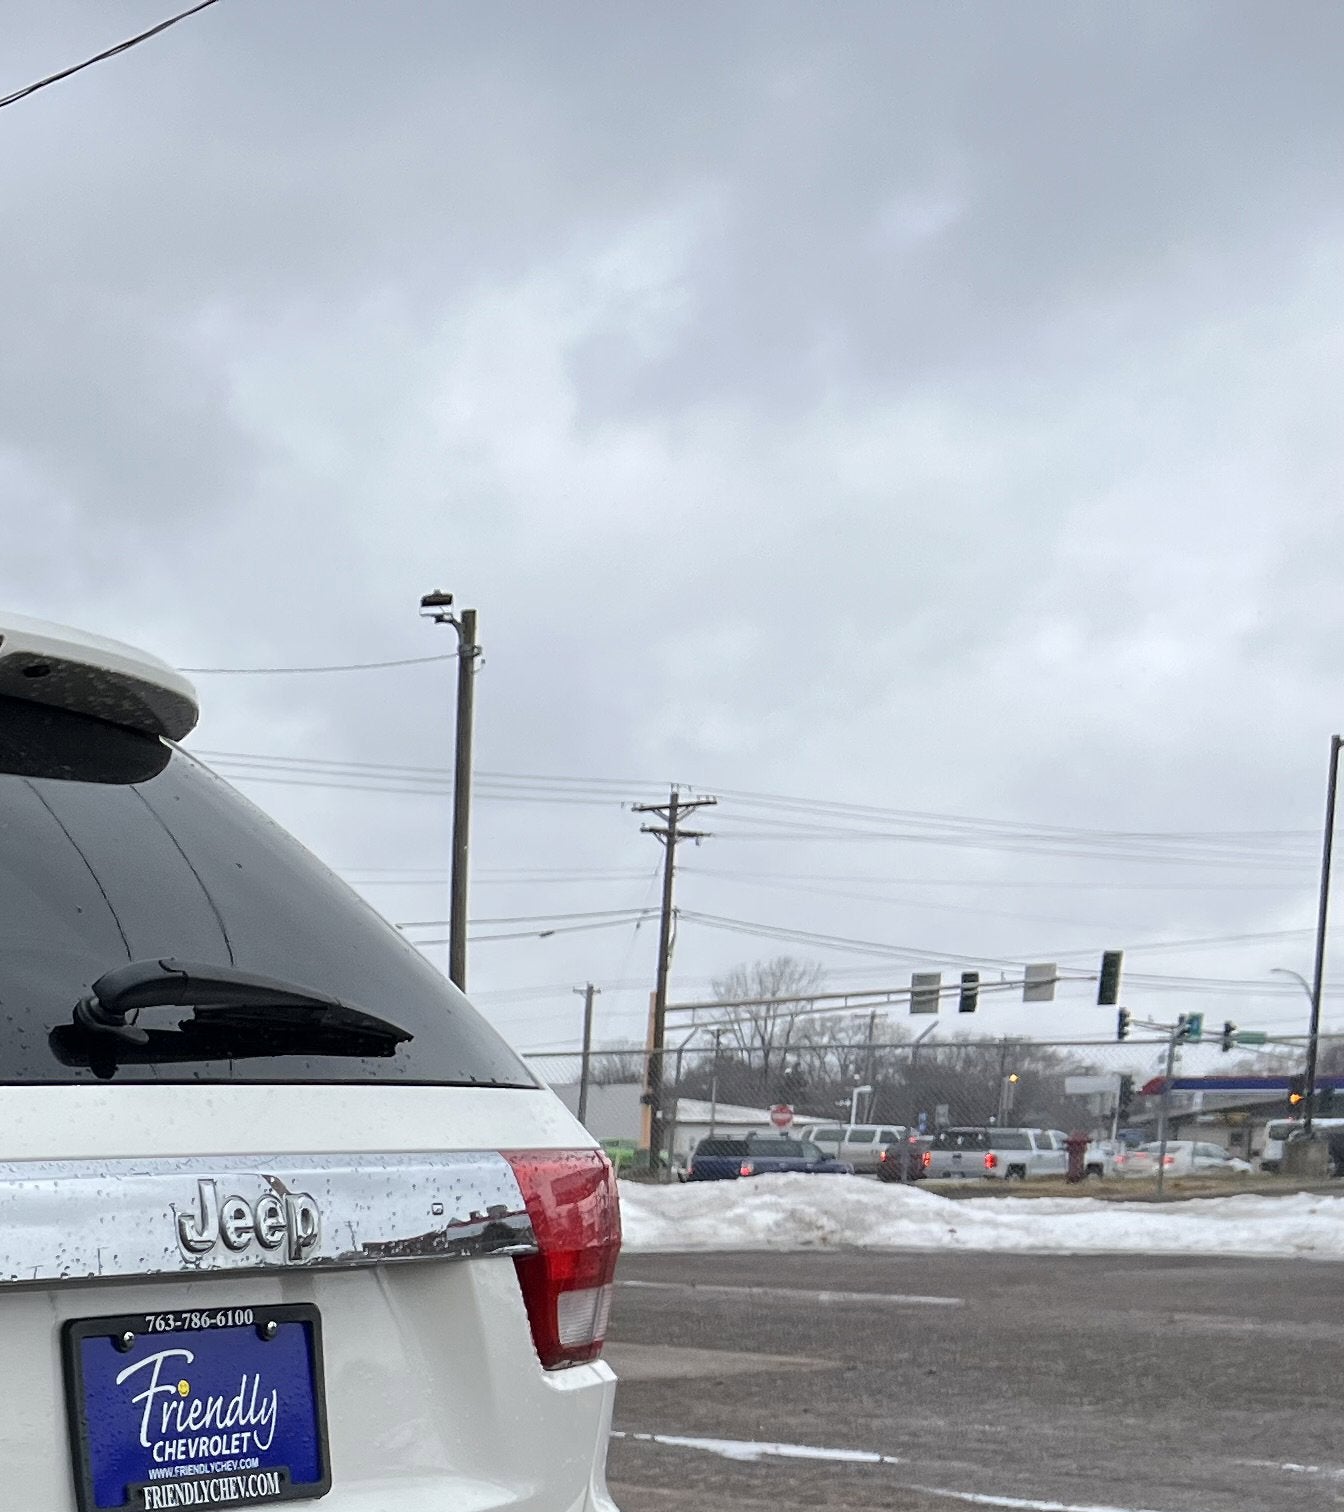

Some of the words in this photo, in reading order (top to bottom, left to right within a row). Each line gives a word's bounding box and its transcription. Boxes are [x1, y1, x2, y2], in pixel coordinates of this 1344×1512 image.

[176, 1178, 320, 1261] Jeep
[145, 1308, 254, 1333] 763-786-6100
[115, 1348, 278, 1451] Friendly
[152, 1431, 252, 1463] CHEVROLET
[148, 1457, 260, 1480] WWW.FRIENDLYCHEV.COM
[142, 1471, 281, 1511] FRIENDLYCHEV.COM
